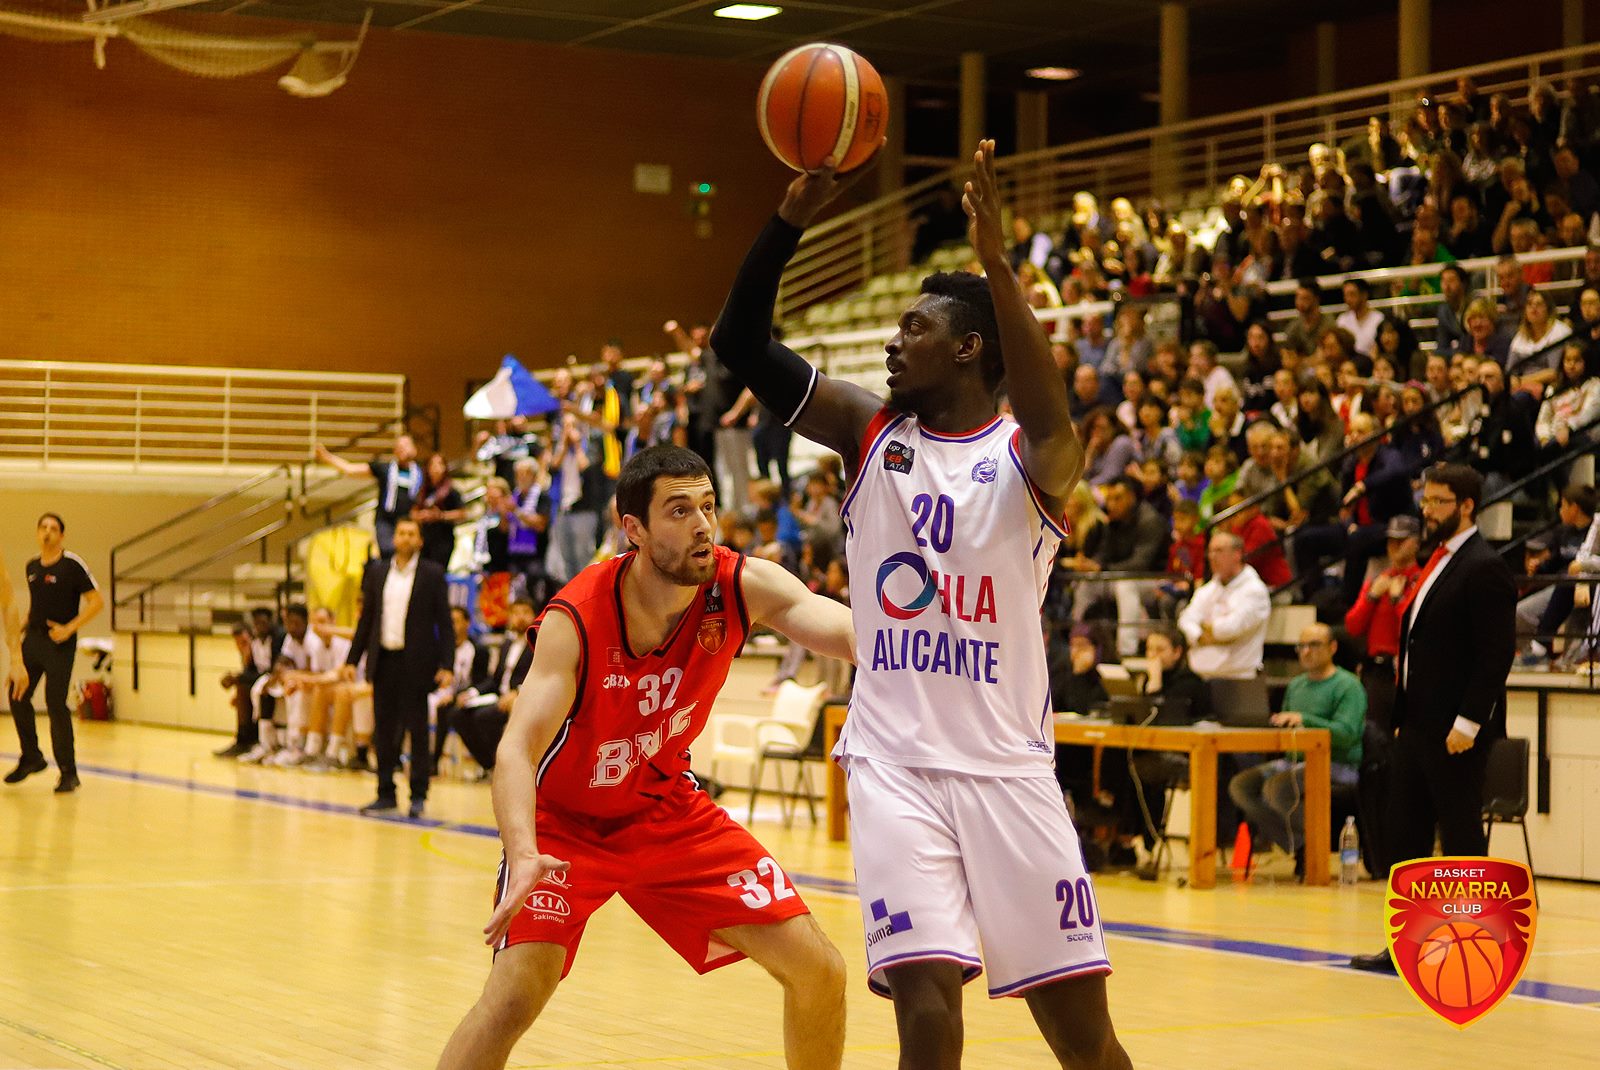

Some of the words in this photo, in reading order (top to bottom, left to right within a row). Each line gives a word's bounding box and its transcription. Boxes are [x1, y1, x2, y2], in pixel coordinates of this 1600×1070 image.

[911, 493, 954, 553] 20
[872, 628, 999, 684] ALICANTE
[637, 667, 683, 716] 32
[532, 895, 565, 913] KIA
[727, 856, 795, 909] 32
[1055, 877, 1094, 930] 20
[867, 924, 893, 948] Suma
